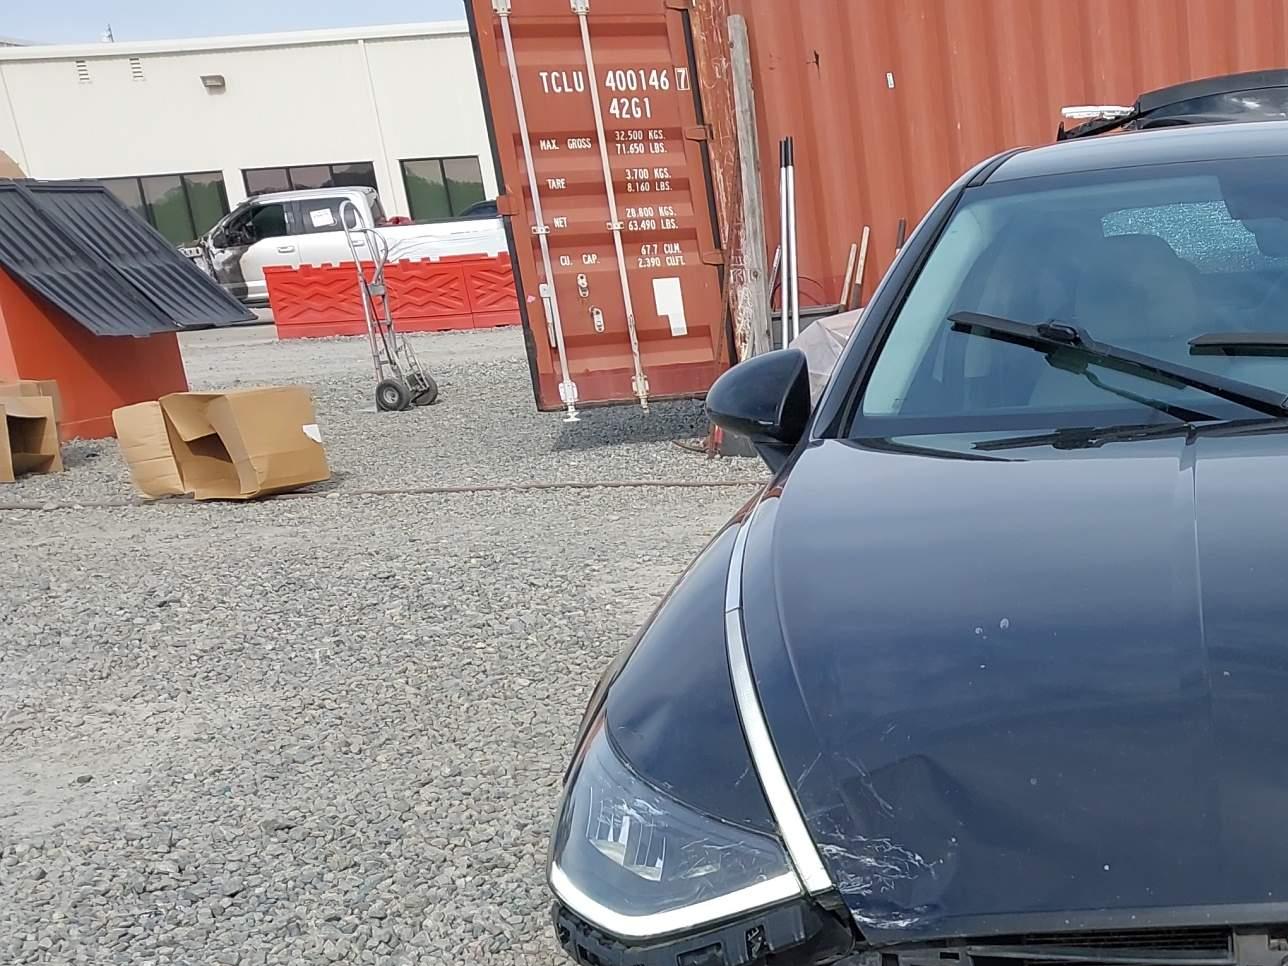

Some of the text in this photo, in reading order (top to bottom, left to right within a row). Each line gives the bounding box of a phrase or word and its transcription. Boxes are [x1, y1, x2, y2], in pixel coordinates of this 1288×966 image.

[539, 71, 585, 94] TCLU
[605, 69, 670, 92] 400146
[609, 97, 651, 119] 42G1
[614, 129, 666, 141] 32.500 KGS.
[539, 138, 592, 151] MAX. GROSS
[616, 142, 668, 155] 71.650 LBS.
[625, 167, 672, 180] 3.700 KGS.
[546, 178, 566, 190] TARE
[627, 181, 673, 193] 8.160 LBS.
[625, 206, 677, 219] 28.800 KGS.
[553, 217, 568, 228] NET
[628, 220, 679, 232] 63.490 LBS.
[640, 244, 658, 256] 67.7
[560, 253, 600, 267] CU. CAP.
[638, 257, 661, 269] 2.390
